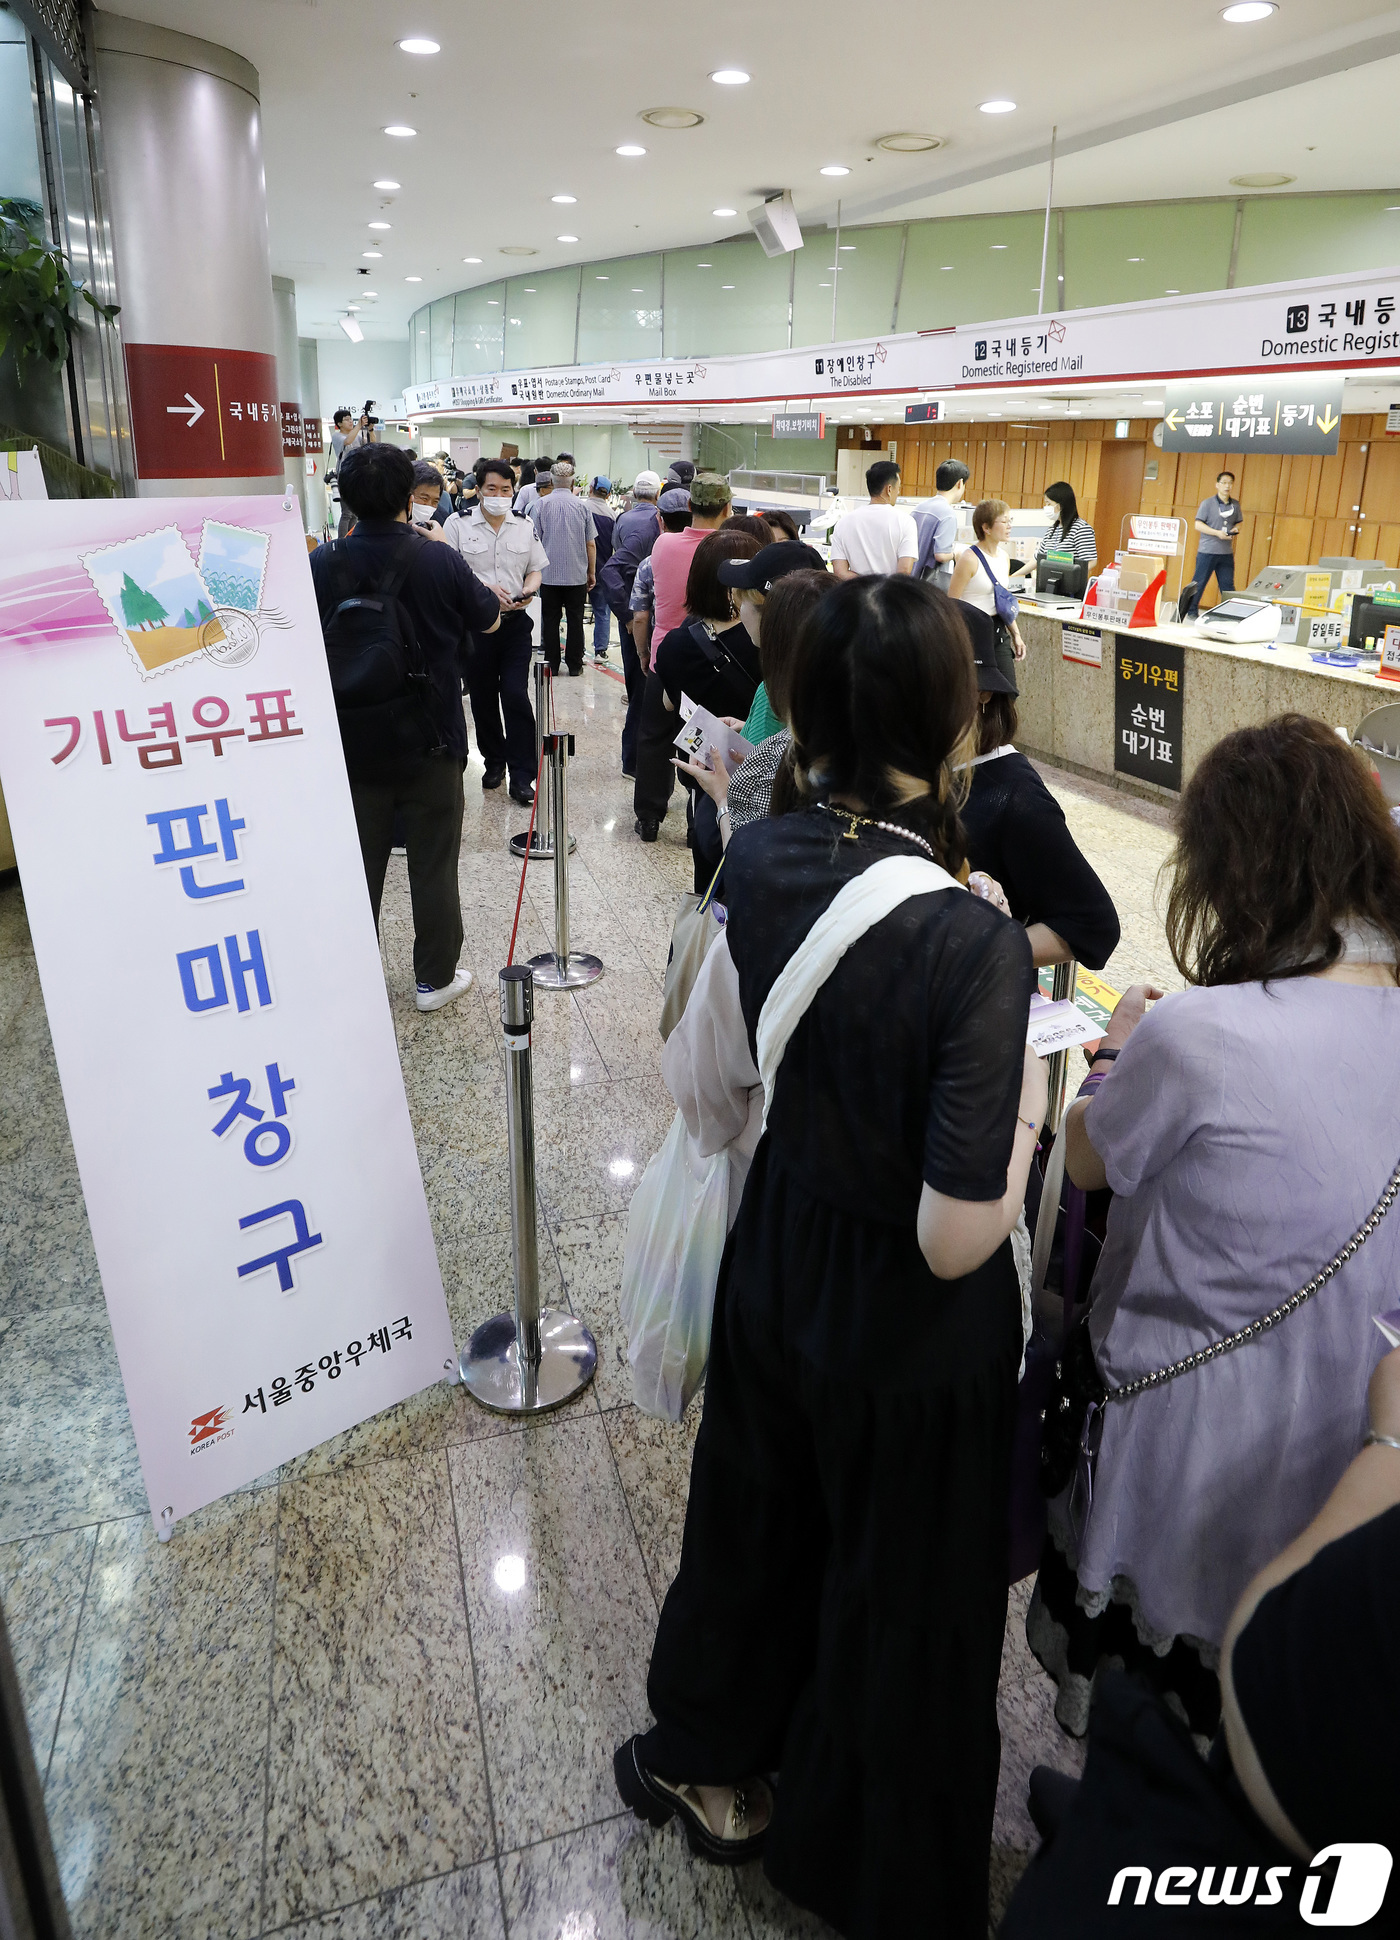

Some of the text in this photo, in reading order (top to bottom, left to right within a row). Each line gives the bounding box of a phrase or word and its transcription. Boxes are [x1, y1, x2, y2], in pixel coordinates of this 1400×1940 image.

[1318, 296, 1396, 328] 국내등
[991, 334, 1048, 358] 국내등기
[1261, 330, 1400, 357] Domestic Regist
[962, 355, 1083, 378] Domestic Registered Mail
[545, 378, 564, 387] Postage
[585, 375, 597, 384] Post
[598, 374, 611, 383] Card
[649, 387, 677, 396] Mail Box
[830, 373, 872, 387] The Disabled
[519, 387, 605, 401] 국내일반 Domestic Ordinary Mail
[1232, 394, 1264, 415] 순번
[229, 401, 278, 422] 국내등기
[1185, 401, 1213, 419] 소포
[1281, 404, 1315, 427] 등기
[1225, 417, 1271, 438] 대기표
[1120, 658, 1178, 692] 등기우편
[43, 688, 304, 770] 기념우표
[1131, 703, 1165, 734] 순번
[1122, 729, 1173, 764] 대기표
[242, 1315, 413, 1414] 서울중앙우체국
[190, 1428, 235, 1456] KOREA POST
